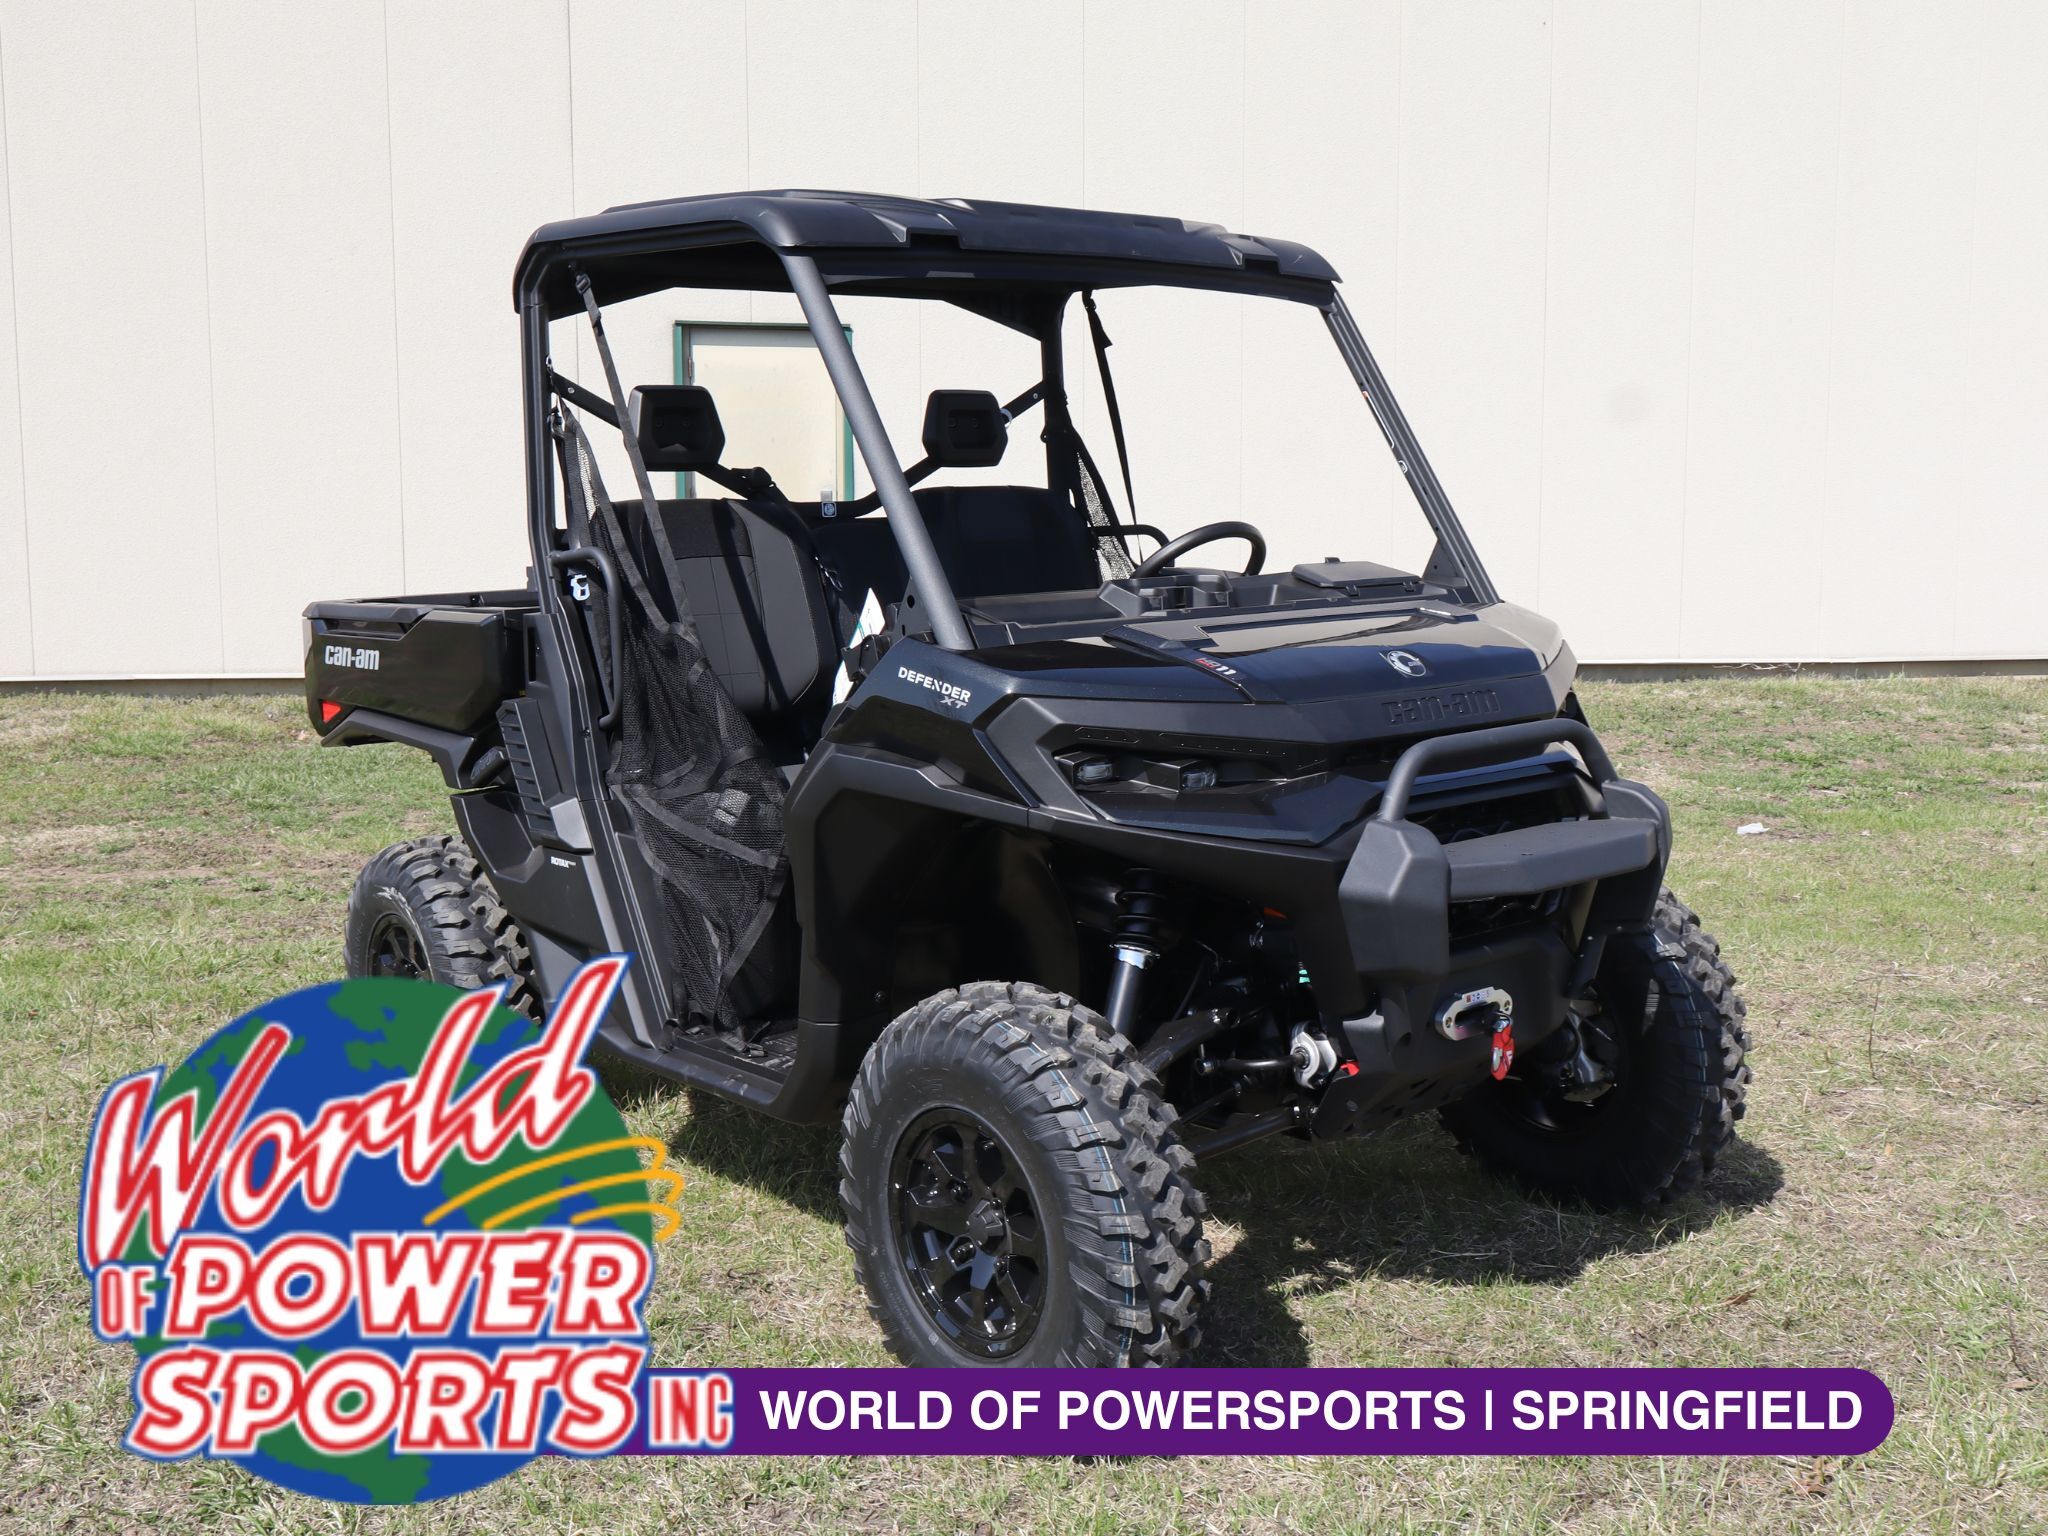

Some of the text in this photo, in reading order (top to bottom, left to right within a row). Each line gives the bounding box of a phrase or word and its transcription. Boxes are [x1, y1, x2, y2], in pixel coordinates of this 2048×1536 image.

[325, 645, 380, 671] can-am
[897, 666, 971, 703] DEFENDER
[940, 695, 967, 709] XT
[1382, 688, 1501, 727] can-am
